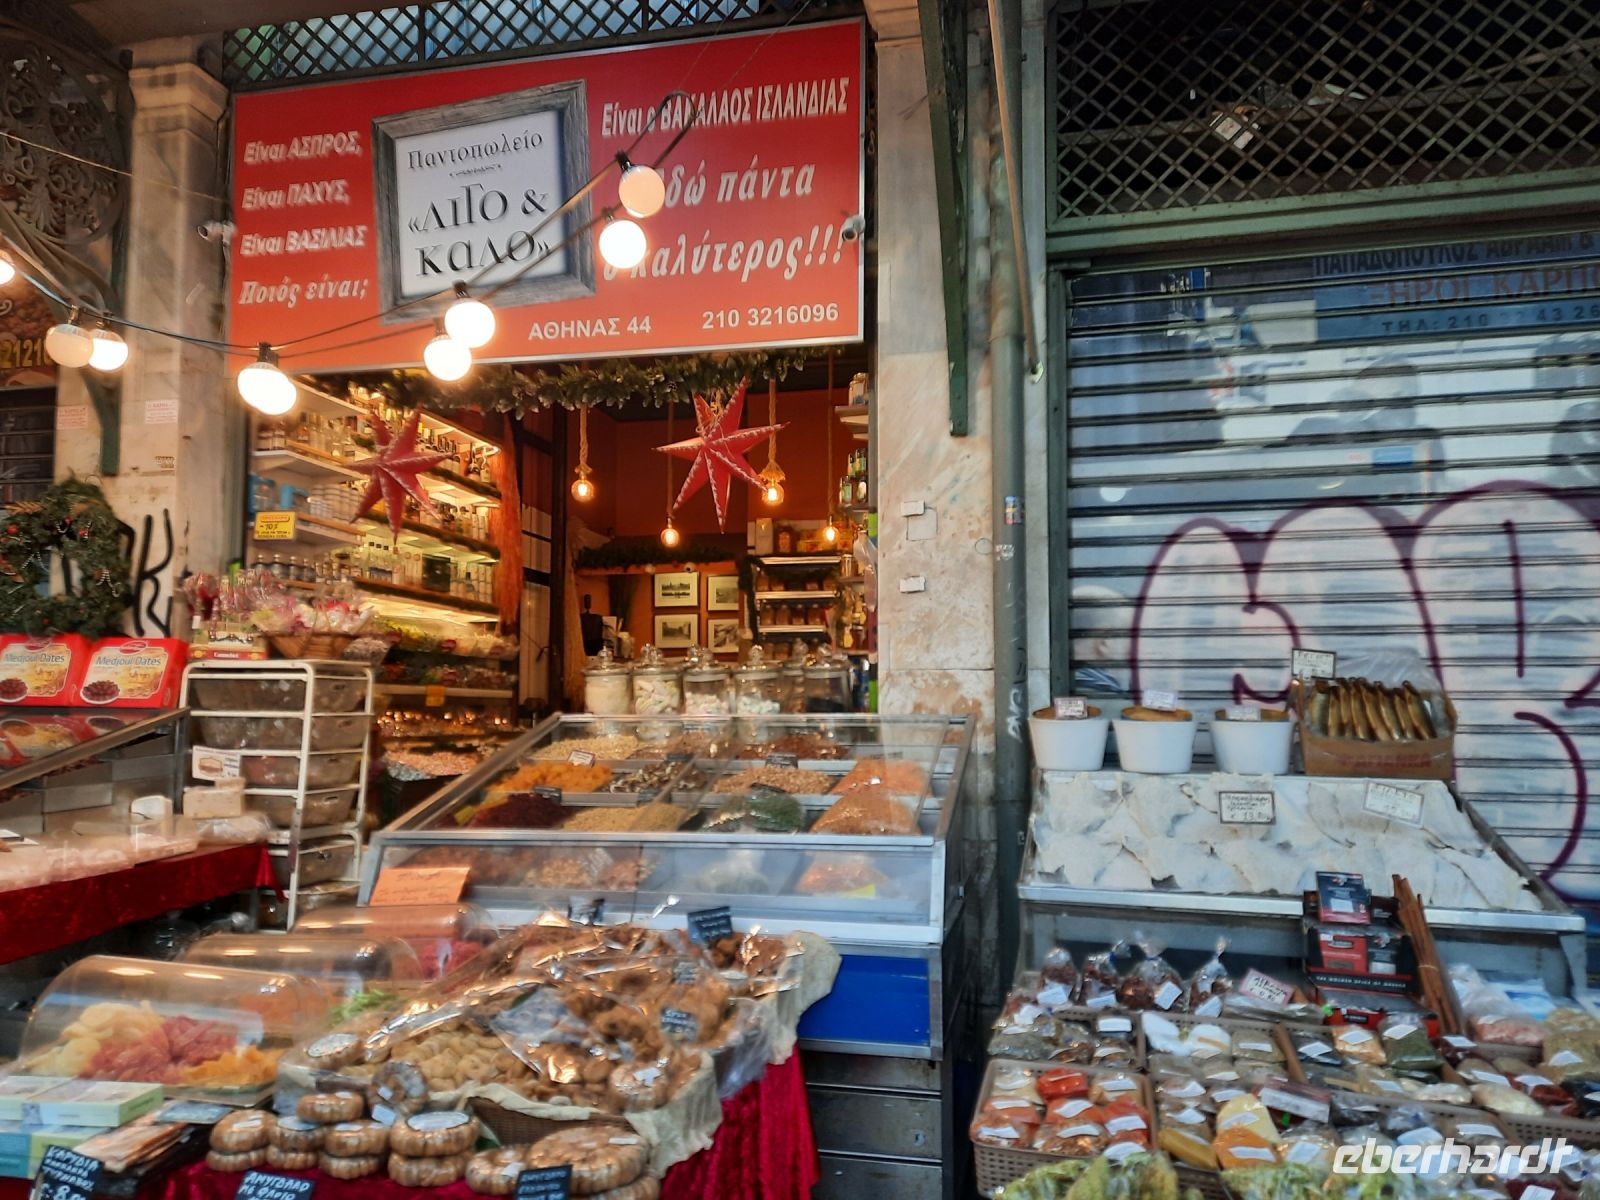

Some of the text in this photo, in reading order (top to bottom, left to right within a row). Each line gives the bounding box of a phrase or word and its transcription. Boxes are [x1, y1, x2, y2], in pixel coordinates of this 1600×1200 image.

[602, 77, 849, 136] Είναι ο ΒΑΚΑΛΑΟΣ ΙΣΛΑΝΔΙΑΣ
[243, 140, 288, 163] Είναι
[408, 129, 543, 169] Παντοπωλείο
[242, 186, 286, 210] Είναι
[656, 155, 816, 208] δώ πάντα
[408, 183, 549, 233] «ΛΙΓΟ &
[240, 233, 284, 256] Είναι
[239, 273, 368, 309] Ποιός είναι;
[528, 303, 839, 341] ΑΘΗΝΑΣ 44 210 3216096
[0, 337, 52, 368] 2121
[5, 653, 65, 664] Medjoul Dates
[96, 656, 162, 667] Medjoul Dates
